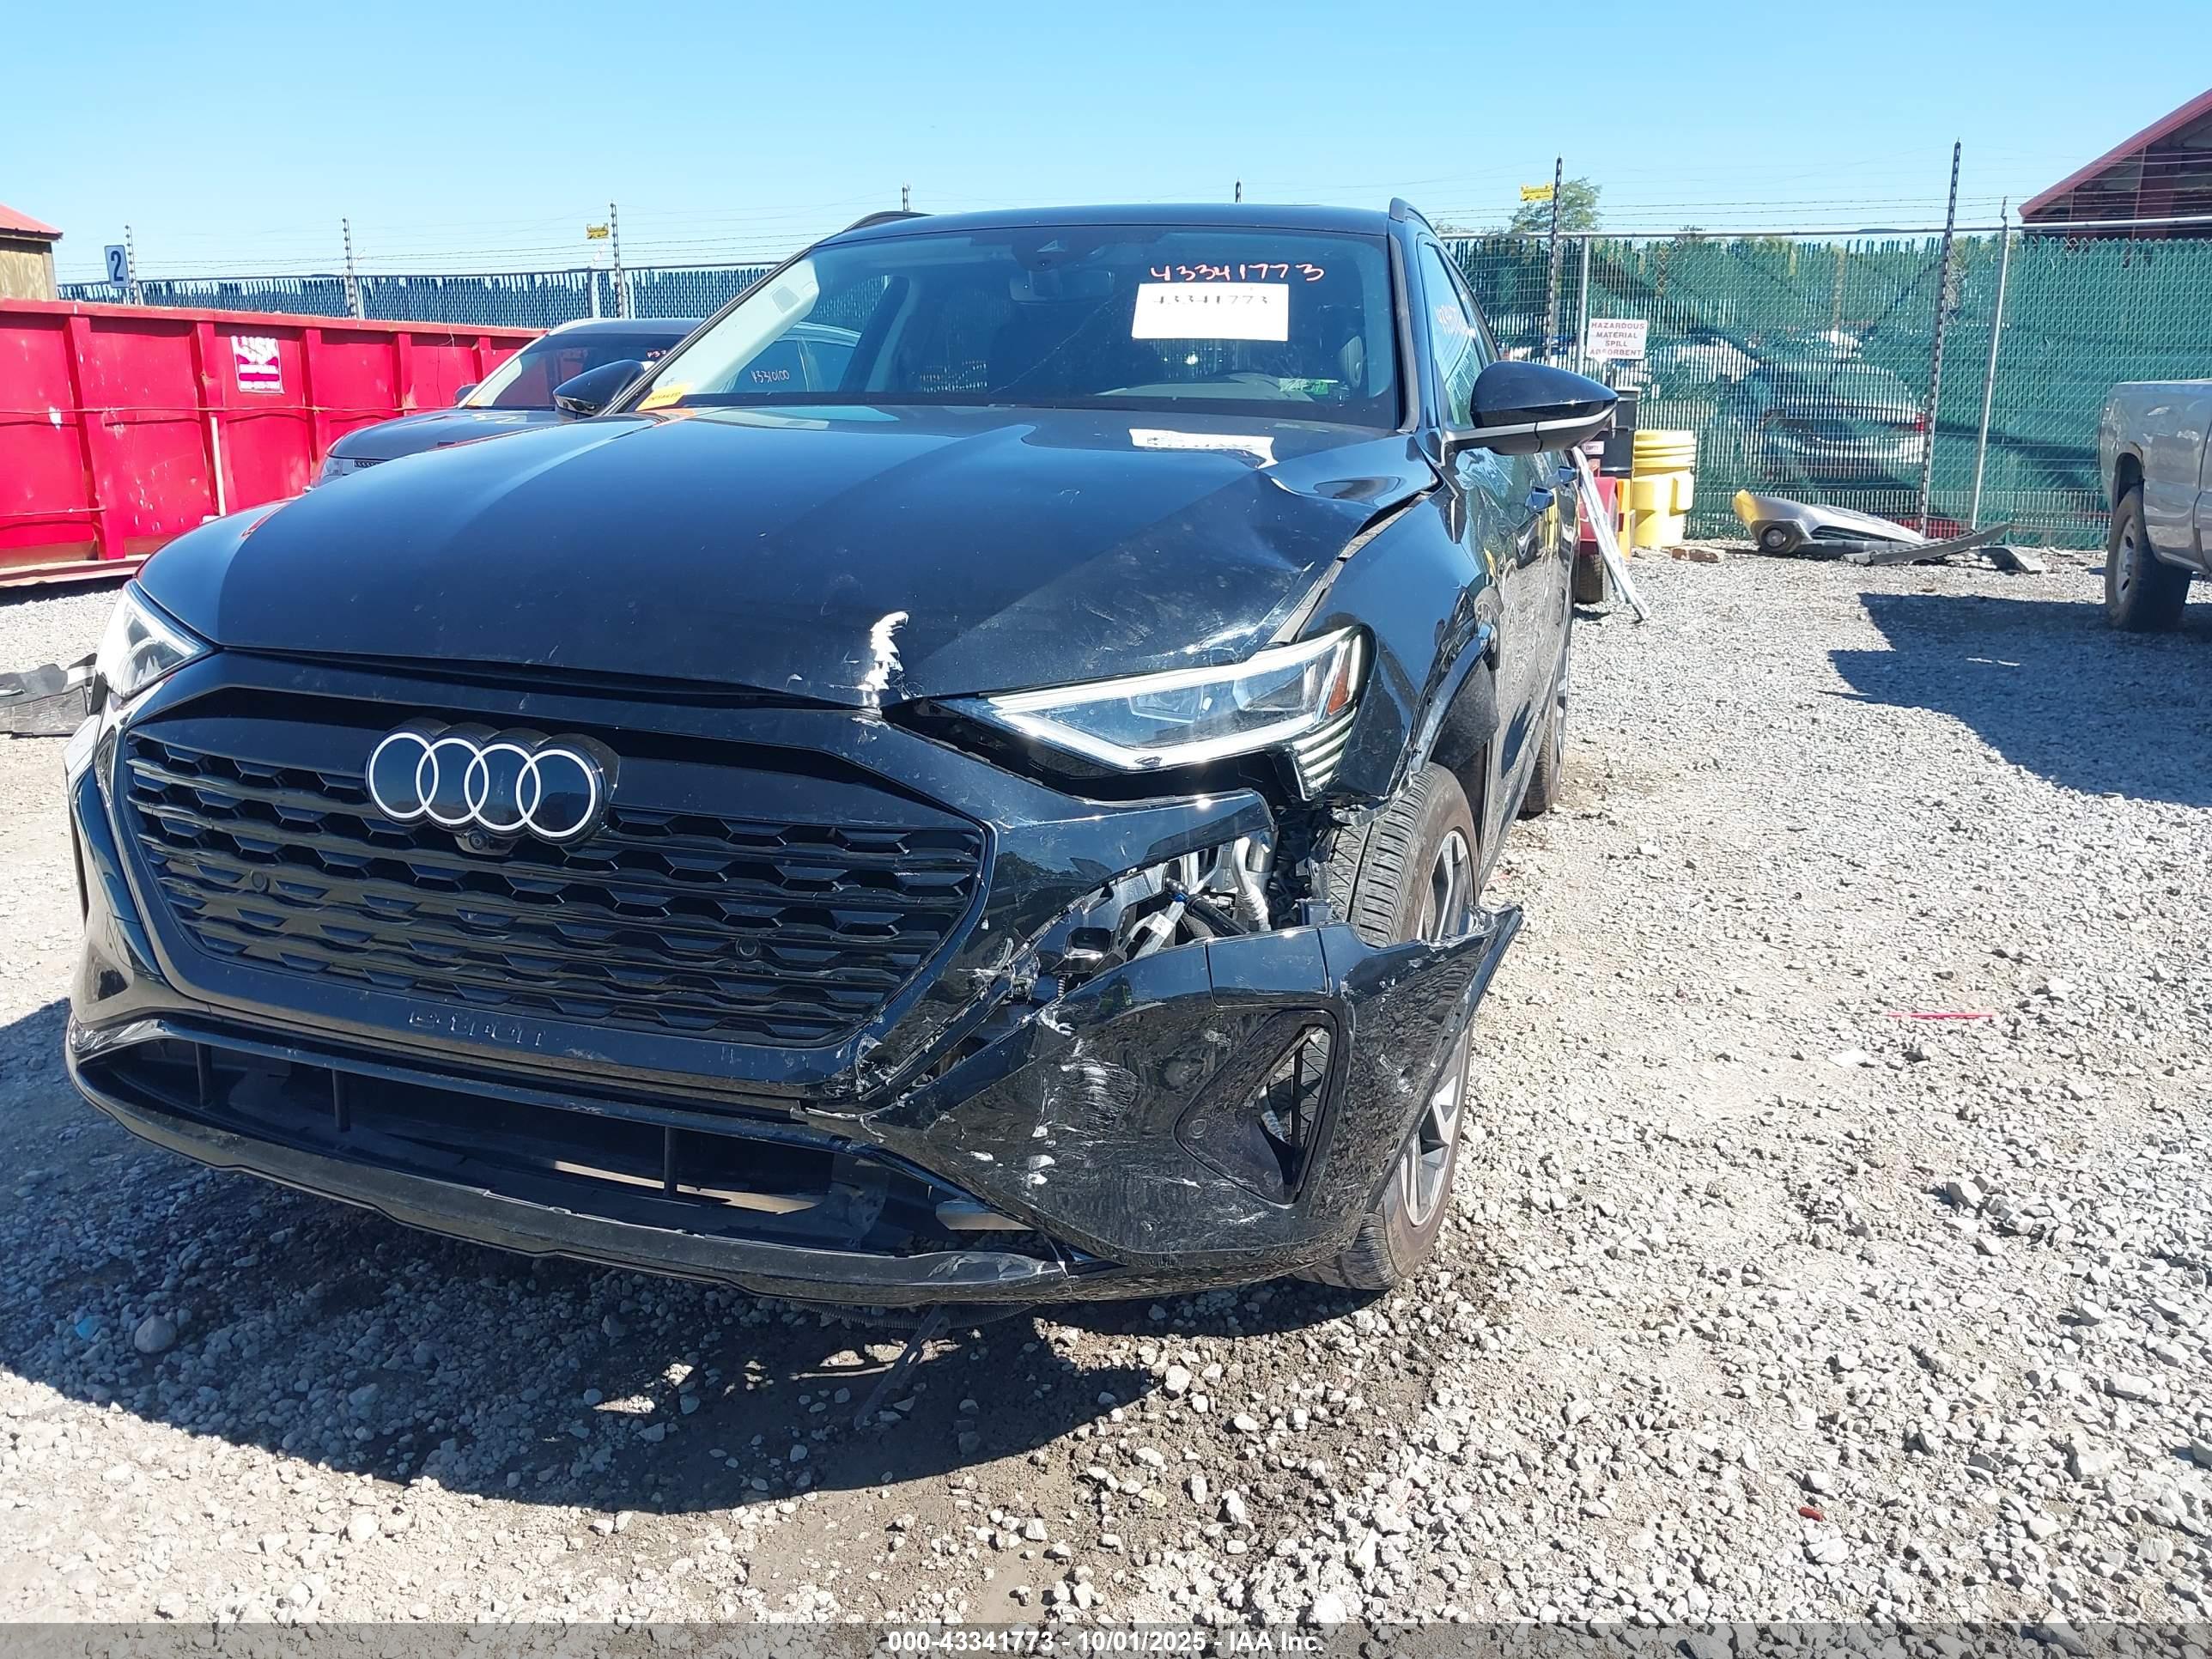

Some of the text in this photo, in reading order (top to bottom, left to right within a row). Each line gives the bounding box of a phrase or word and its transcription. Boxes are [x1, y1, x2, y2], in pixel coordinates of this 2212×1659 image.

[110, 250, 125, 282] 2
[1150, 263, 1325, 282] 43341773
[1154, 295, 1268, 305] 43341773
